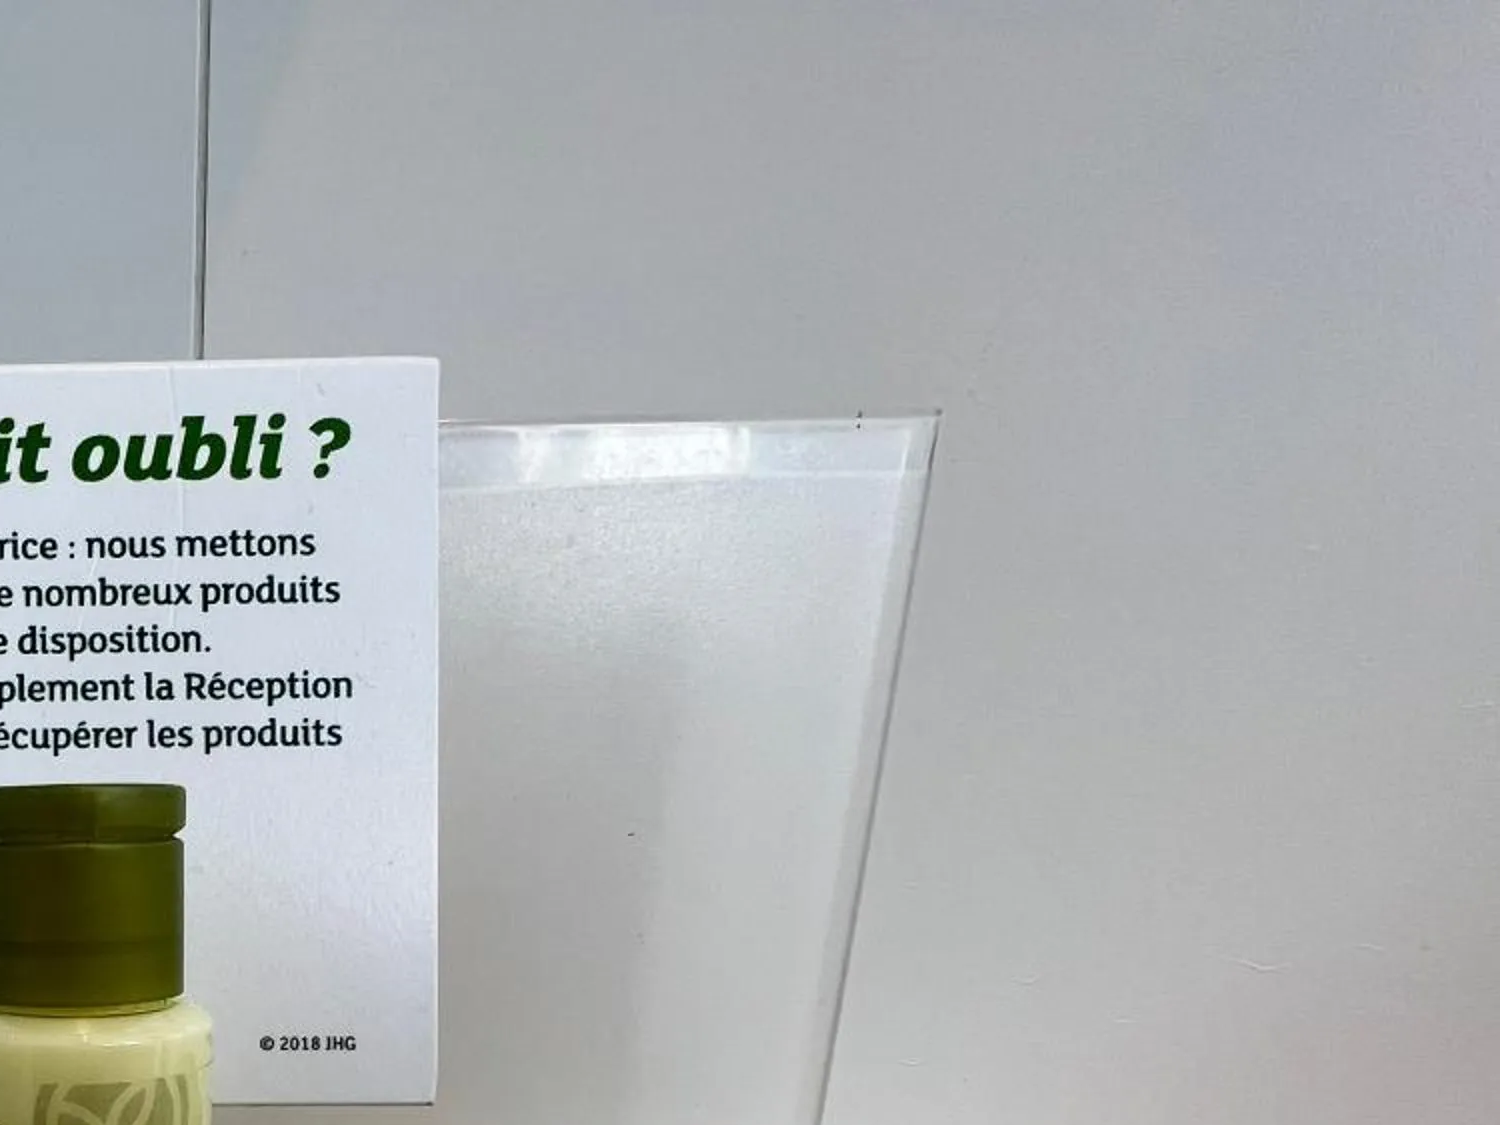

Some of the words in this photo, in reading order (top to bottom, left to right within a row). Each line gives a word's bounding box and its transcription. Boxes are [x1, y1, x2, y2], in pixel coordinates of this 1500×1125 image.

[71, 412, 287, 483] oubli
[308, 417, 352, 479] ?
[85, 535, 167, 559] nous
[175, 529, 316, 557] mettons
[21, 577, 193, 607] nombreux
[199, 574, 341, 613] produits
[17, 623, 211, 662] disposition.
[143, 671, 176, 701] la
[183, 669, 353, 707] Réception
[146, 719, 194, 749] les
[201, 717, 343, 755] produits
[279, 1035, 321, 1051] 2018
[325, 1035, 357, 1051] IHG
